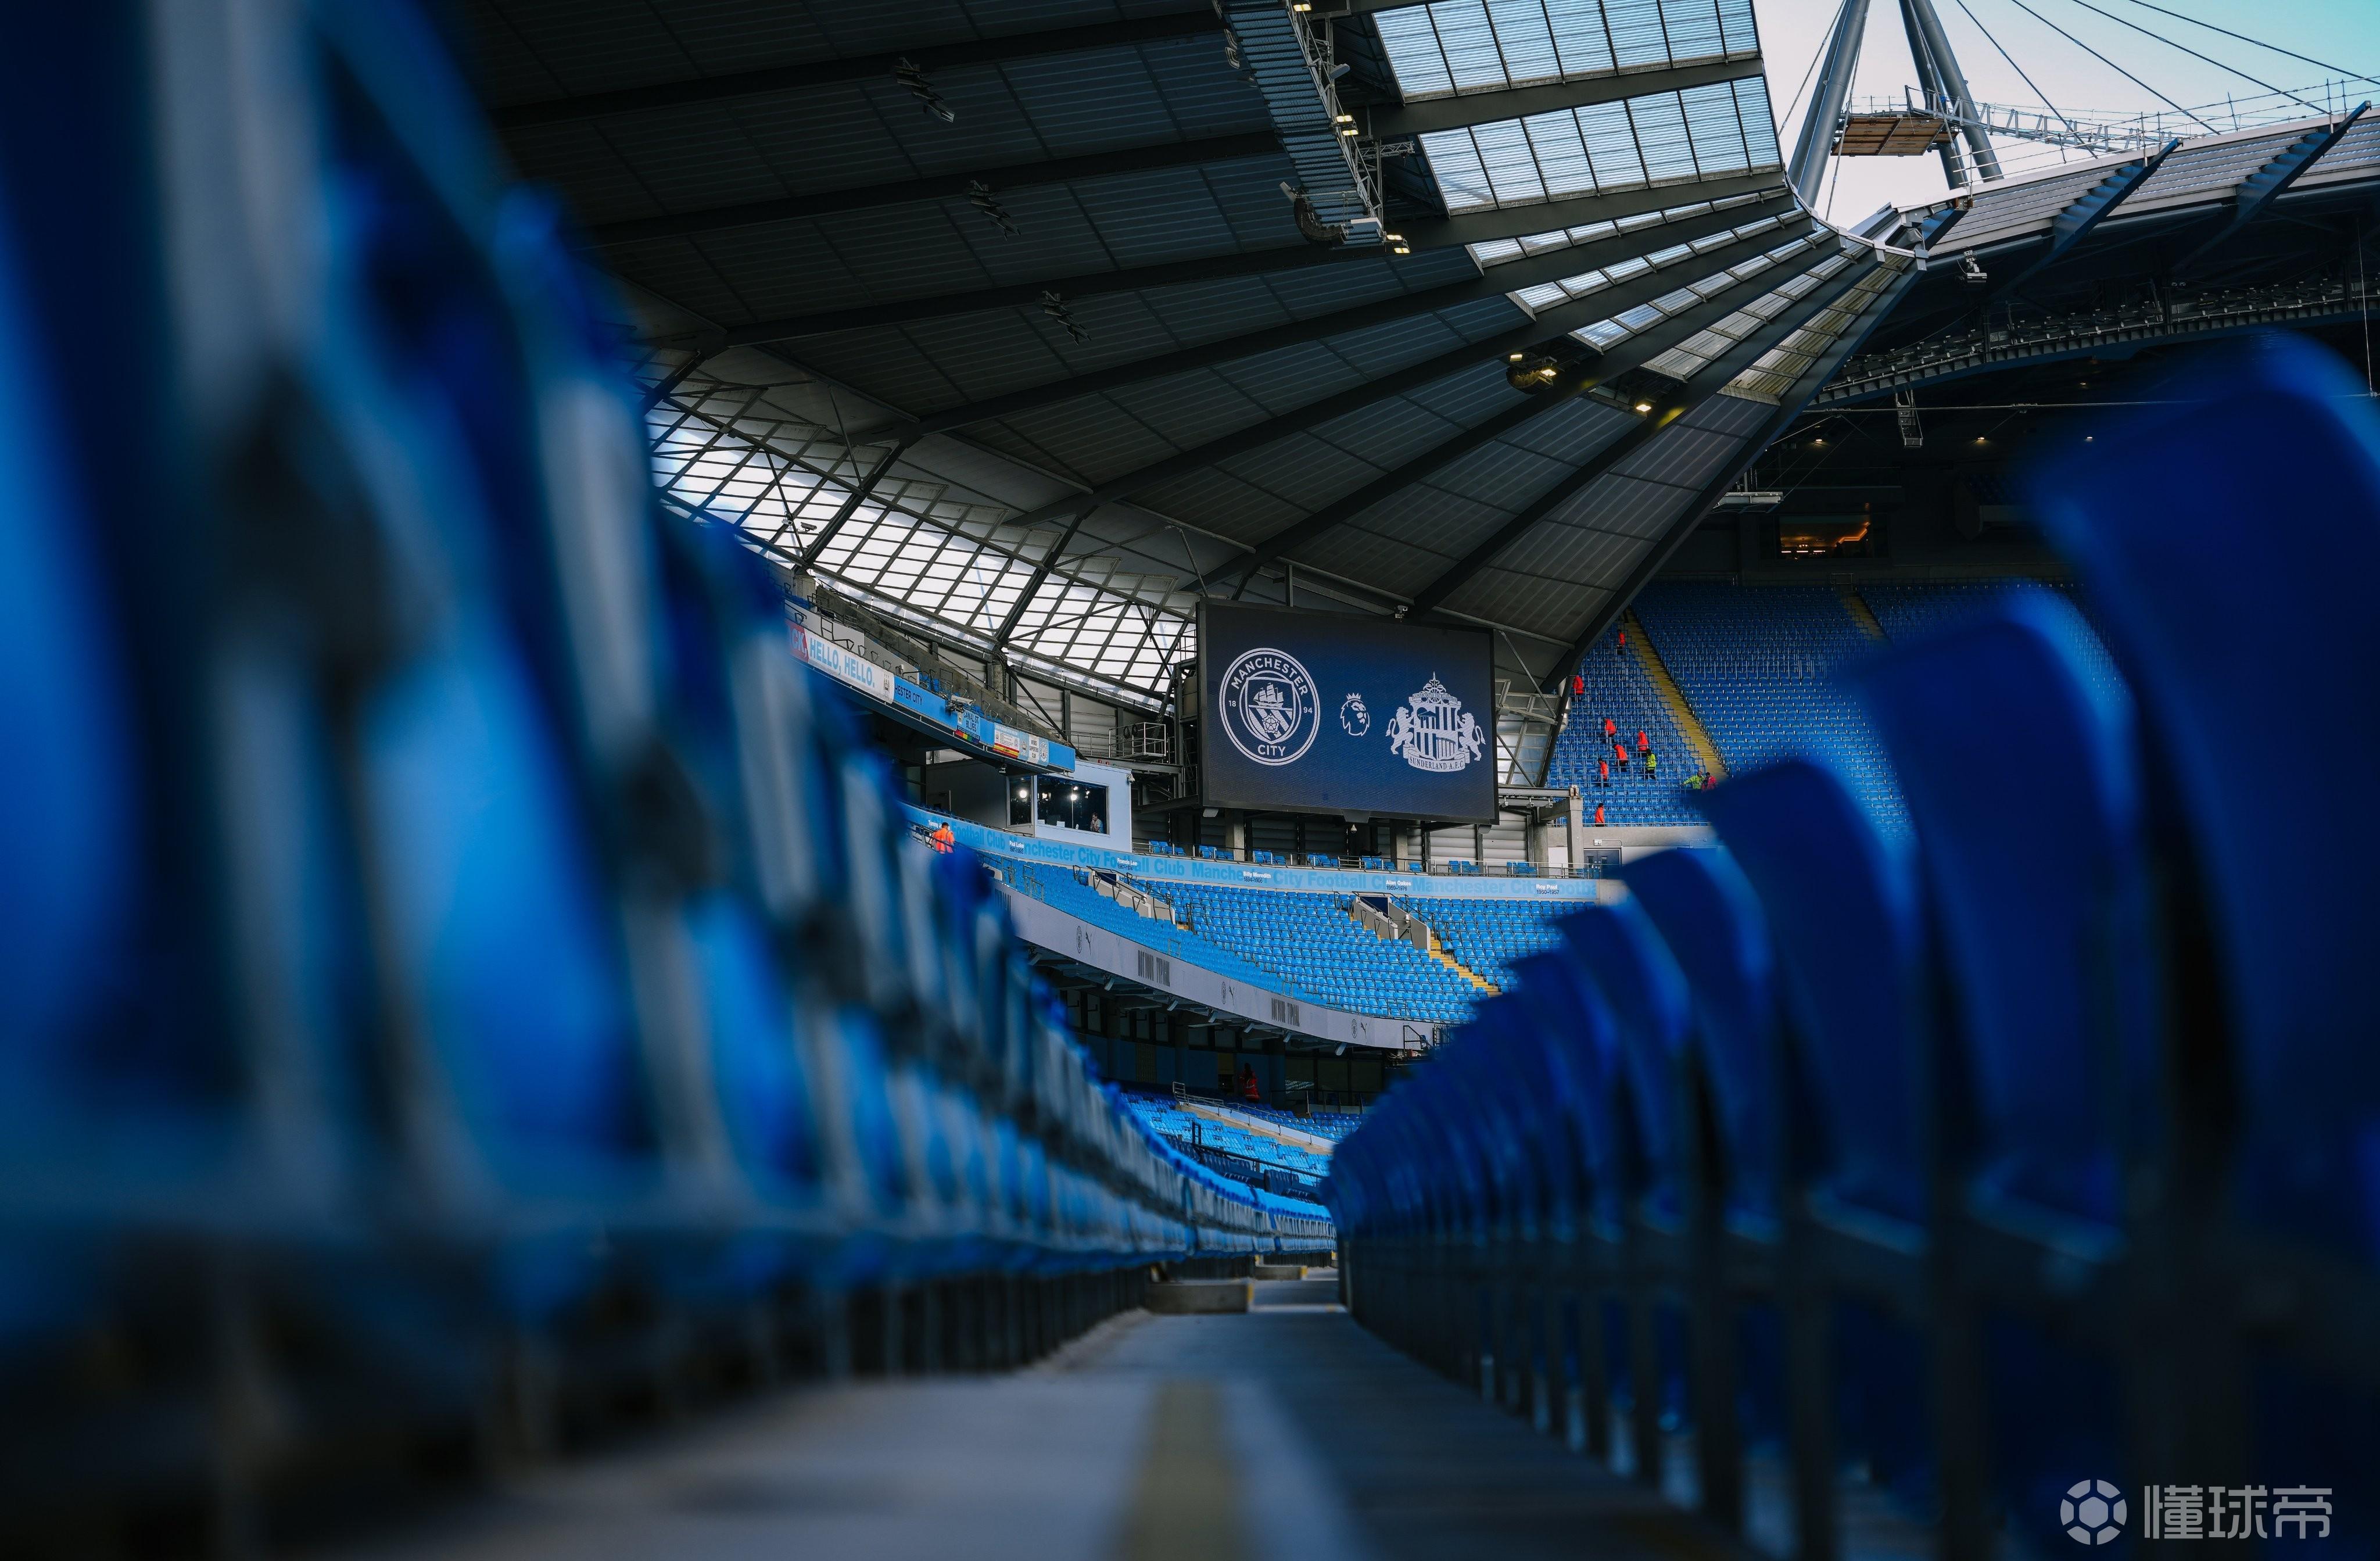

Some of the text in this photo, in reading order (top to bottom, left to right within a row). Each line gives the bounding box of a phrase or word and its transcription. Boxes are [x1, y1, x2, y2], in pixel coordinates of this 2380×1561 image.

[810, 638, 841, 676] HELLO,
[844, 655, 874, 688] HELLO.
[1231, 657, 1308, 696] MANCHESTER
[912, 692, 923, 705] CITY
[963, 710, 979, 724] CANAL ST
[966, 720, 976, 732] BLUES
[1257, 744, 1286, 756] CITY
[1409, 756, 1465, 770] SUNDERLAND A.F.C.
[951, 821, 984, 844] Football
[987, 830, 1005, 850] Club
[1078, 847, 1100, 867] City
[1104, 851, 1149, 872] Foall
[1154, 858, 1185, 876] Club
[1273, 869, 1303, 889] City
[1307, 872, 1365, 889] Football
[1412, 877, 1506, 893] Manchester
[1511, 879, 1537, 895] Cit
